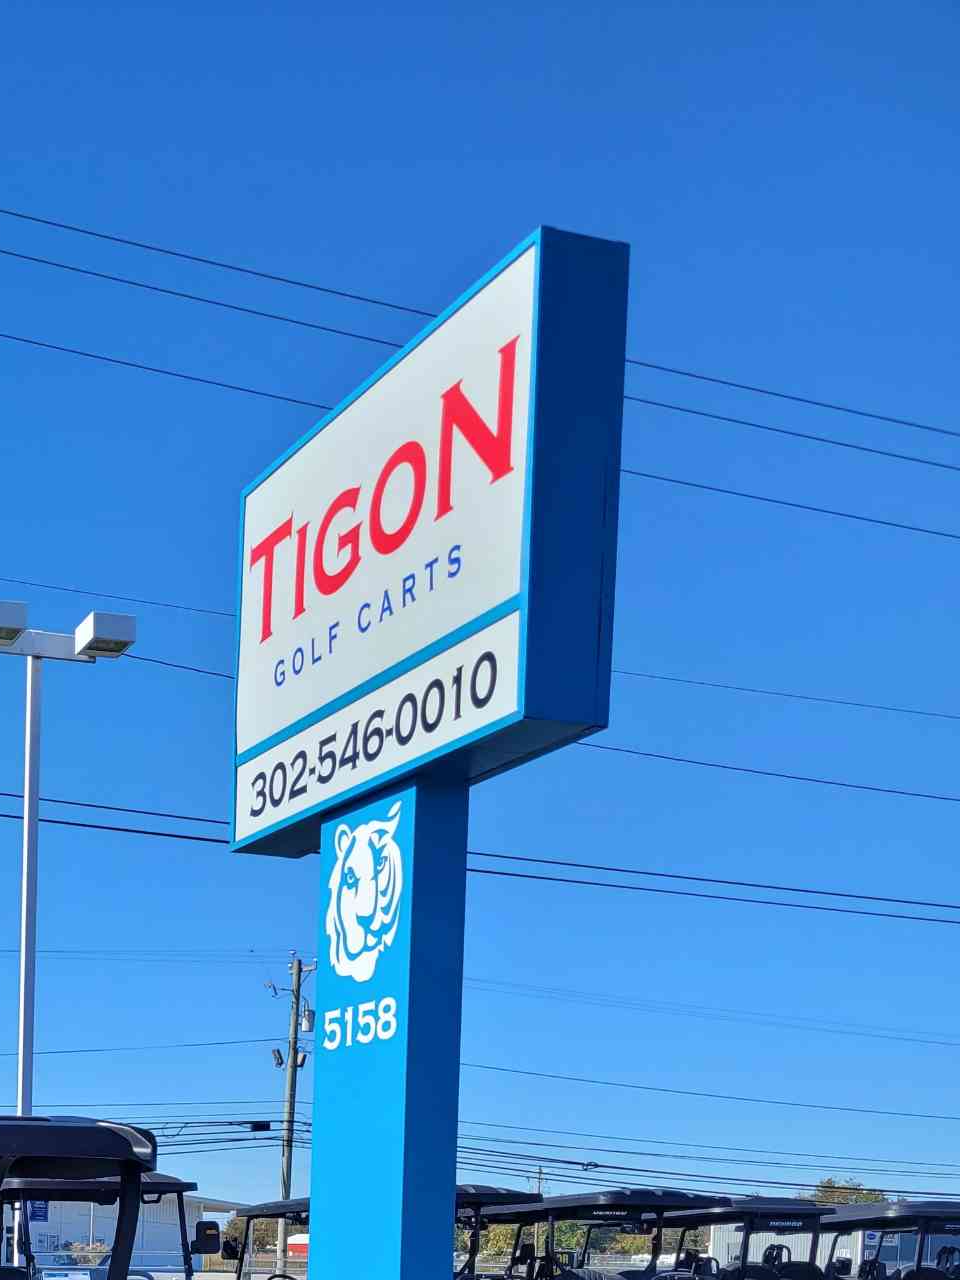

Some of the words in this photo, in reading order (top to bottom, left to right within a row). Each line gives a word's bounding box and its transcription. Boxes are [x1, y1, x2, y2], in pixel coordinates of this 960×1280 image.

[249, 334, 520, 644] TIGON
[273, 621, 340, 687] GOLF
[357, 544, 462, 634] CARTS
[249, 650, 498, 818] 302-546-0010
[322, 996, 397, 1050] 5158
